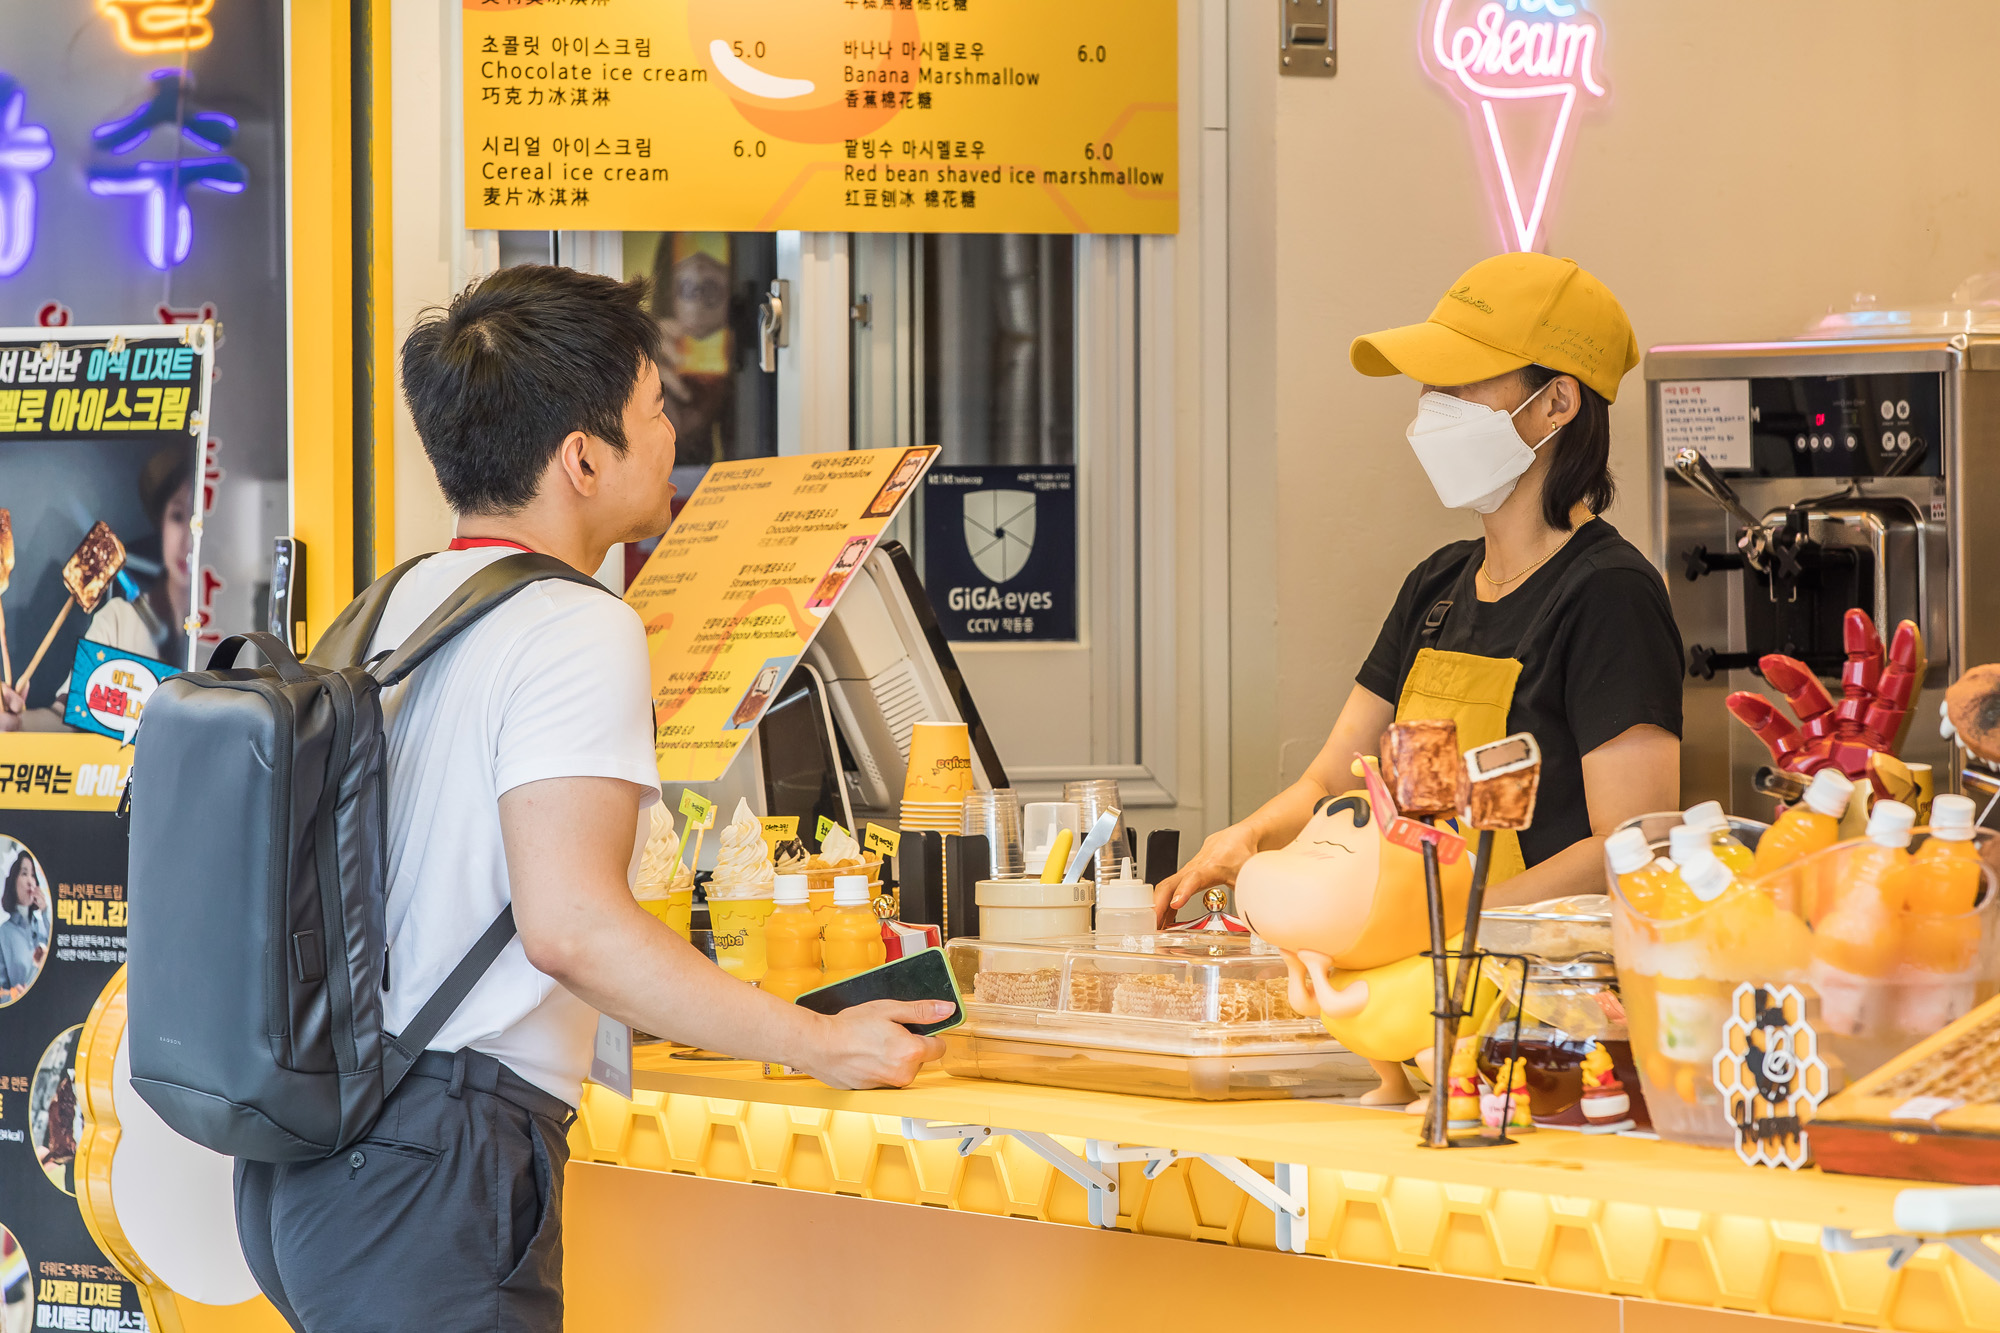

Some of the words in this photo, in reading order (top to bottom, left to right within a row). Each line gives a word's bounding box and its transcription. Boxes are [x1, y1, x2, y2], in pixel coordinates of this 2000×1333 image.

[481, 35, 540, 57] 초콜릿
[552, 37, 651, 58] 아이스크림
[733, 41, 767, 58] 5.0
[844, 41, 892, 60] 바나나
[903, 41, 985, 61] 마시멜로우
[1077, 45, 1107, 63] 6.0
[1433, 0, 1605, 97] Cream
[481, 61, 592, 80] Chocolate
[602, 63, 633, 81] ice
[643, 67, 708, 82] cream
[844, 66, 910, 84] Banana
[919, 68, 1040, 86] Marshmallow
[482, 86, 611, 107] 巧克力冰淇淋
[845, 90, 932, 109] 香蕉棉花糖
[482, 136, 541, 157] 시리얼
[553, 138, 651, 158] 아이스크림
[734, 141, 767, 158] 6.0
[845, 139, 893, 160] 팥빙수
[903, 140, 986, 160] 마시멜로우
[1085, 143, 1113, 160] 6.0
[482, 162, 552, 181] Cereal
[563, 163, 594, 181] ice
[604, 166, 669, 182] cream
[845, 165, 877, 183] Red
[886, 165, 929, 183] bean
[937, 165, 1001, 184] shaved
[1009, 167, 1036, 184] ice
[1043, 167, 1164, 186] marshmallow
[925, 190, 977, 209] 棉花糖
[87, 348, 130, 382] 이색
[130, 347, 194, 382] 디저트
[49, 387, 191, 432] 아이스크림
[803, 472, 826, 481] Vanilla
[827, 470, 873, 479] Marshmallow
[766, 525, 802, 533] Chocolate
[802, 522, 849, 531] marshmallow
[729, 578, 770, 589] Strawberry
[770, 575, 817, 585] marshmallow
[631, 589, 646, 597] Soft
[948, 587, 1001, 612] GiGA
[1004, 591, 1053, 615] eyes
[695, 631, 722, 642] Injeolmi
[722, 629, 753, 642] Dalgona
[751, 629, 799, 639] Marshmallow
[967, 618, 1000, 634] CCTV
[1002, 617, 1034, 634] 작동중
[659, 685, 686, 696] Banana
[685, 684, 733, 695] Marshmallow
[691, 739, 740, 749] marshmallow
[0, 764, 72, 794] 구워먹는
[37, 1279, 79, 1305] 사계절
[80, 1282, 122, 1308] 디저트
[91, 1307, 150, 1333] 아이스크
